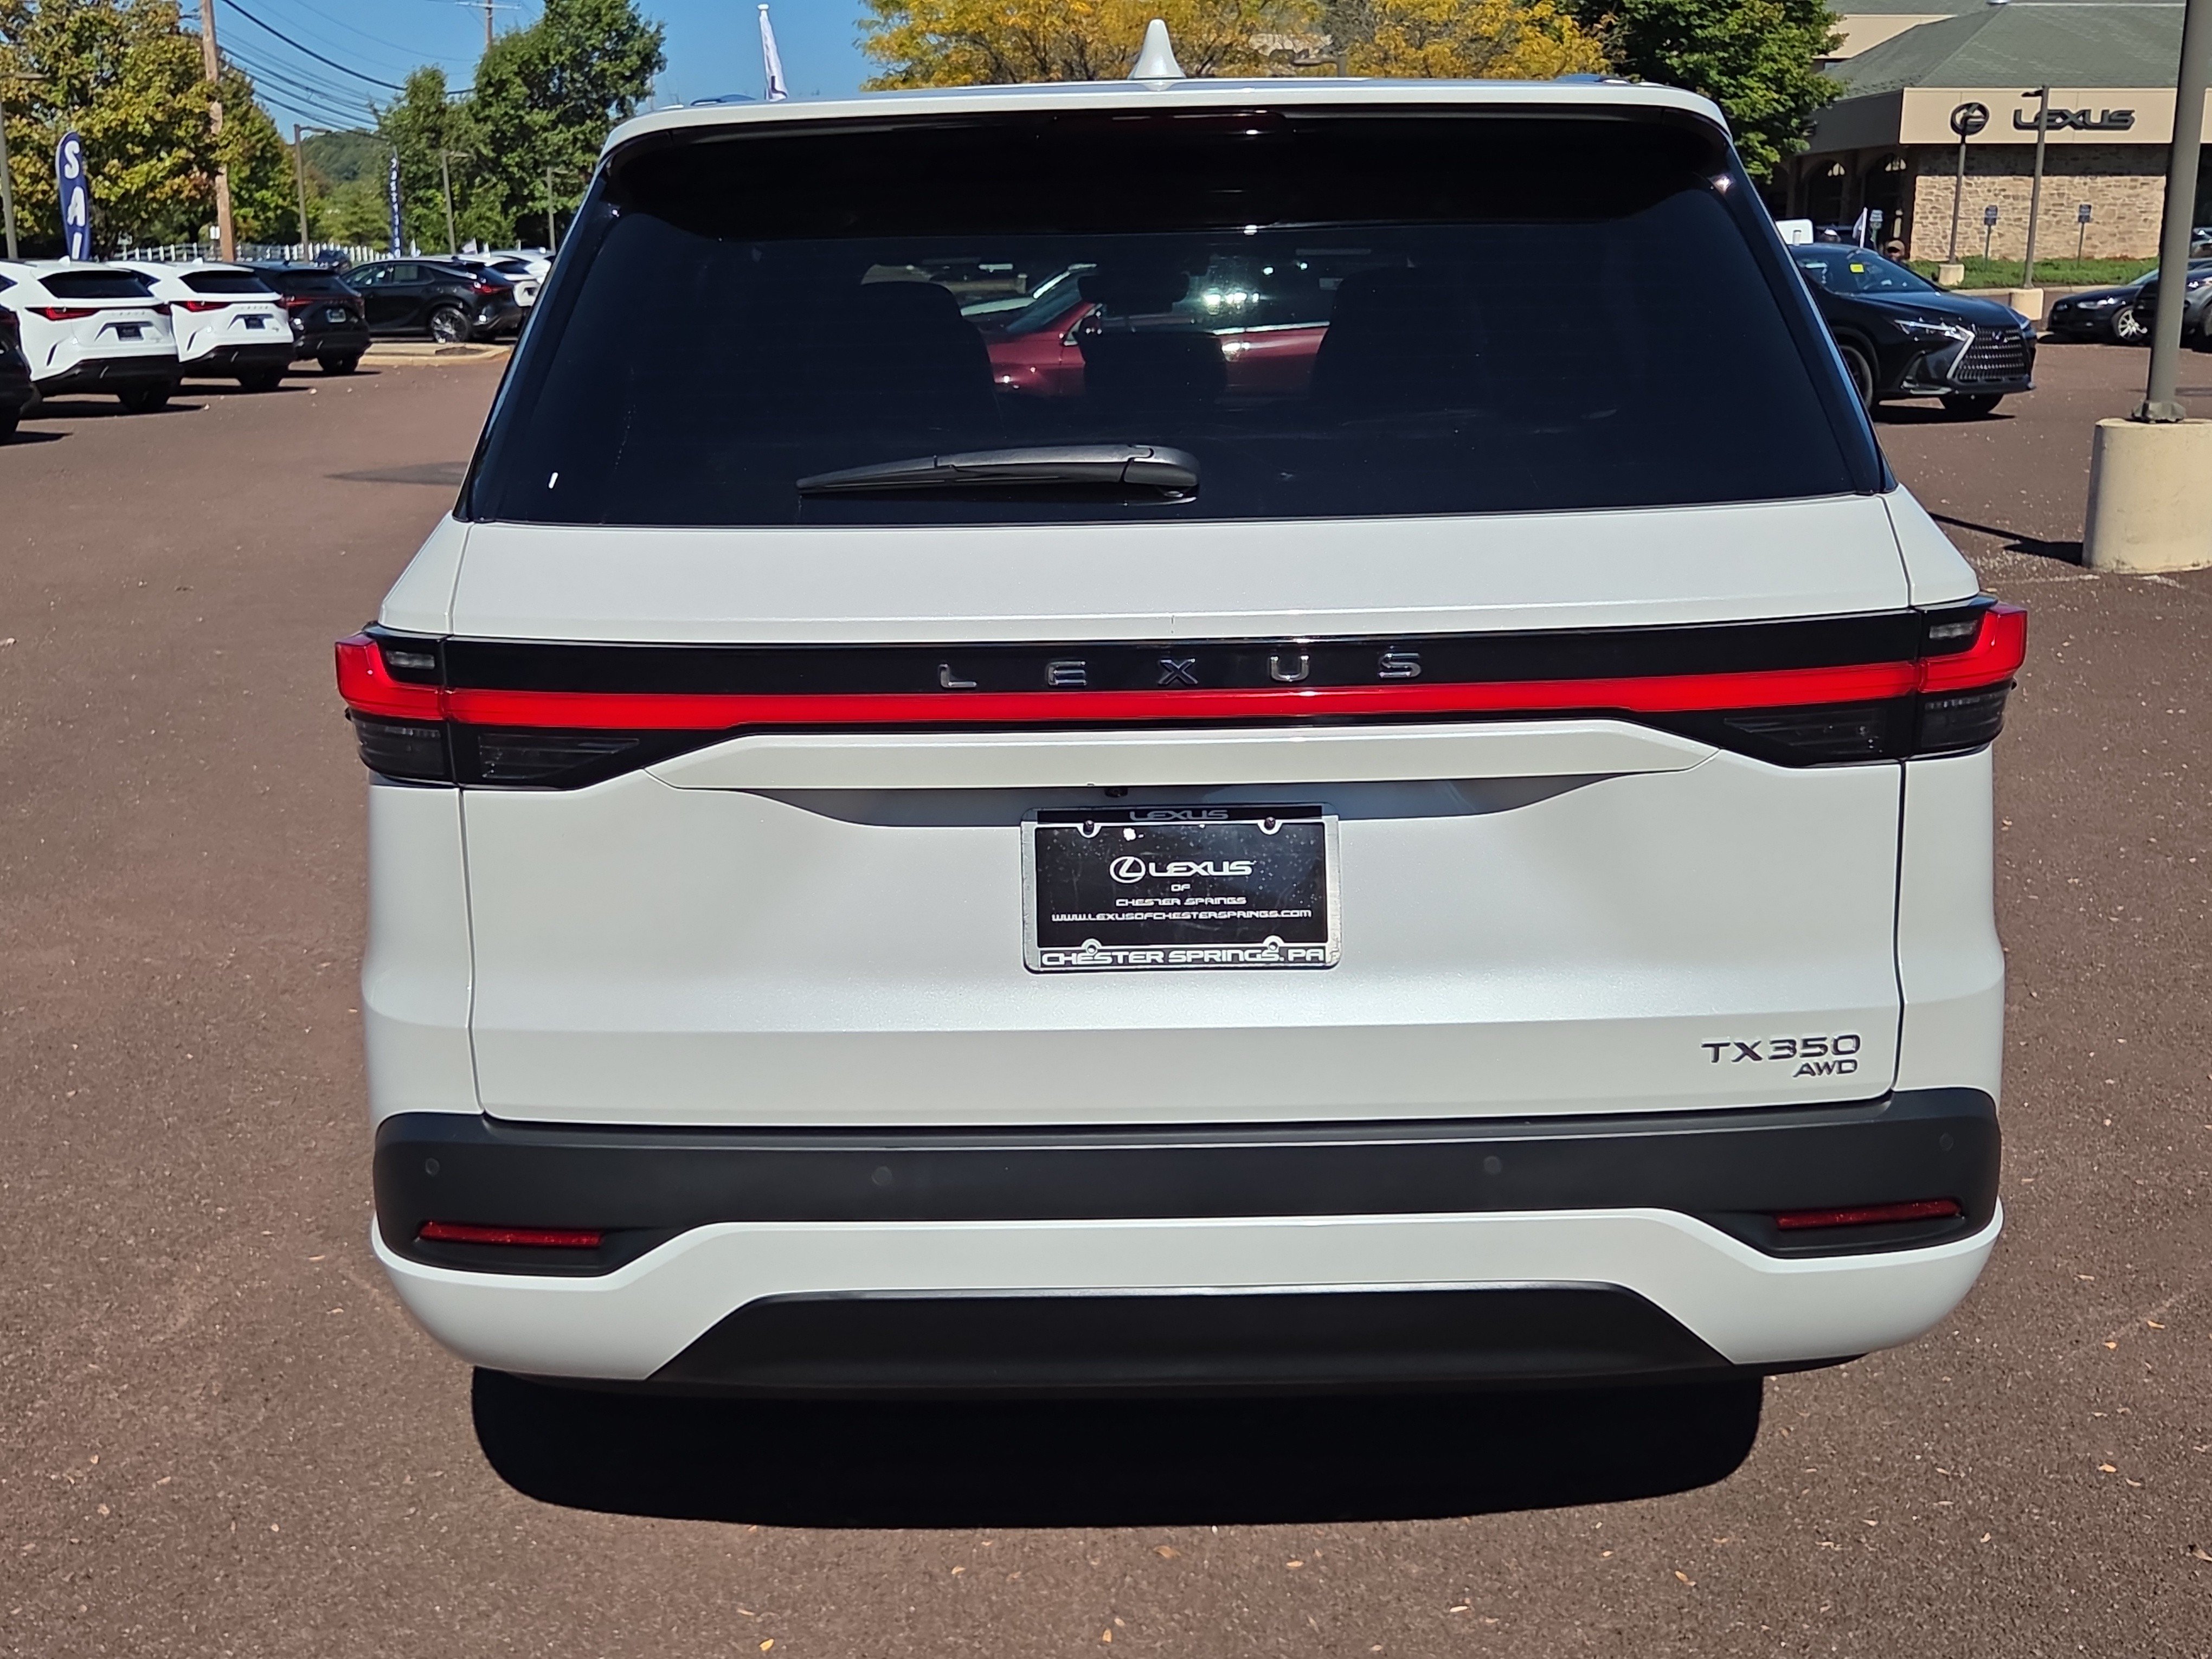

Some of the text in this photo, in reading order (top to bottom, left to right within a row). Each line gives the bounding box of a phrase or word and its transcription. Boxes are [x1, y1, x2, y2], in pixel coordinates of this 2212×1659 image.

[2014, 109, 2135, 130] LEXUS
[938, 653, 1420, 689] LEXUS
[1130, 810, 1229, 821] LEXUS
[1148, 861, 1253, 877] LEXUS
[1116, 897, 1247, 906] CHESTER SPRINGS
[1041, 950, 1164, 966] CHESTER
[1288, 949, 1324, 962] PA
[1792, 1059, 1858, 1077] AWD
